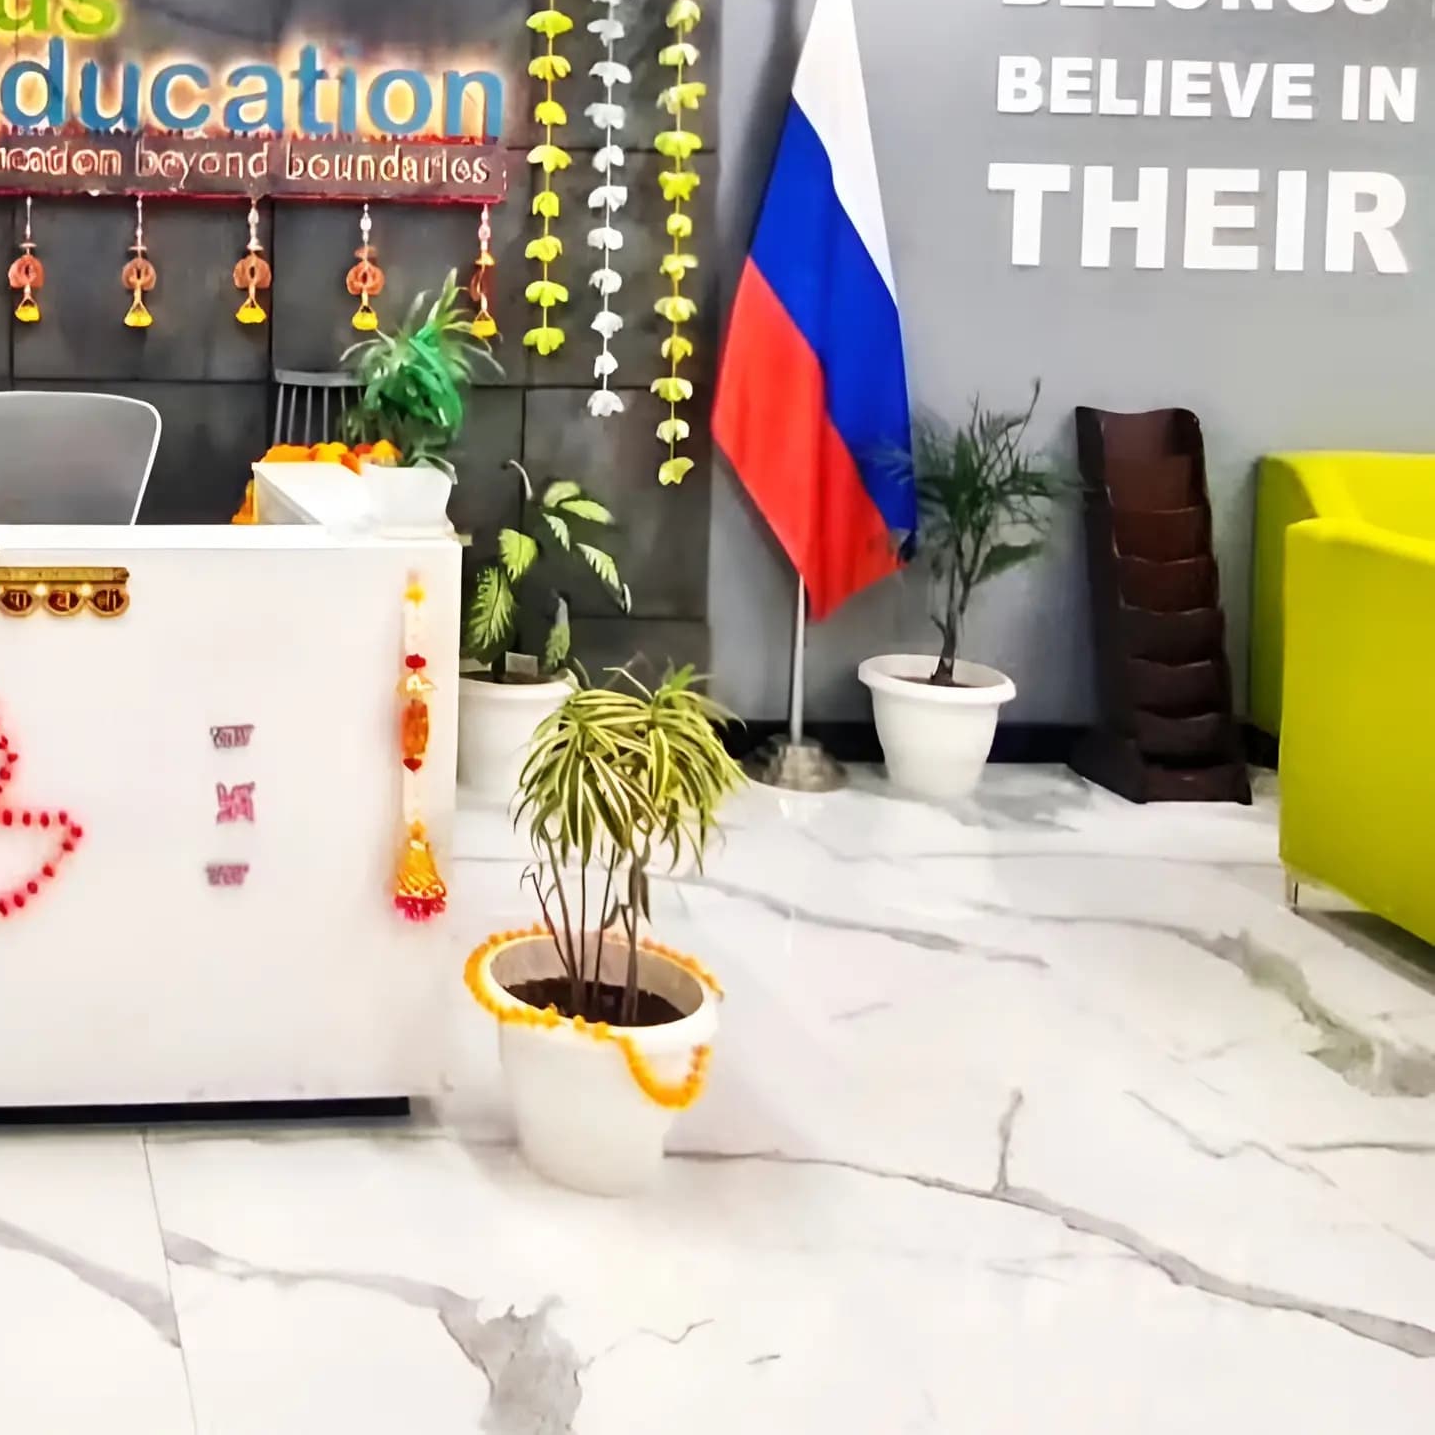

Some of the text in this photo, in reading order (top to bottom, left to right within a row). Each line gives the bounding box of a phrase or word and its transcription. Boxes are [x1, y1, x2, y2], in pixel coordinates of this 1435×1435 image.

[996, 55, 1418, 123] BELIEVE IN
[134, 138, 268, 190] beyond
[285, 141, 490, 185] boundaries
[986, 162, 1410, 274] THEIR
